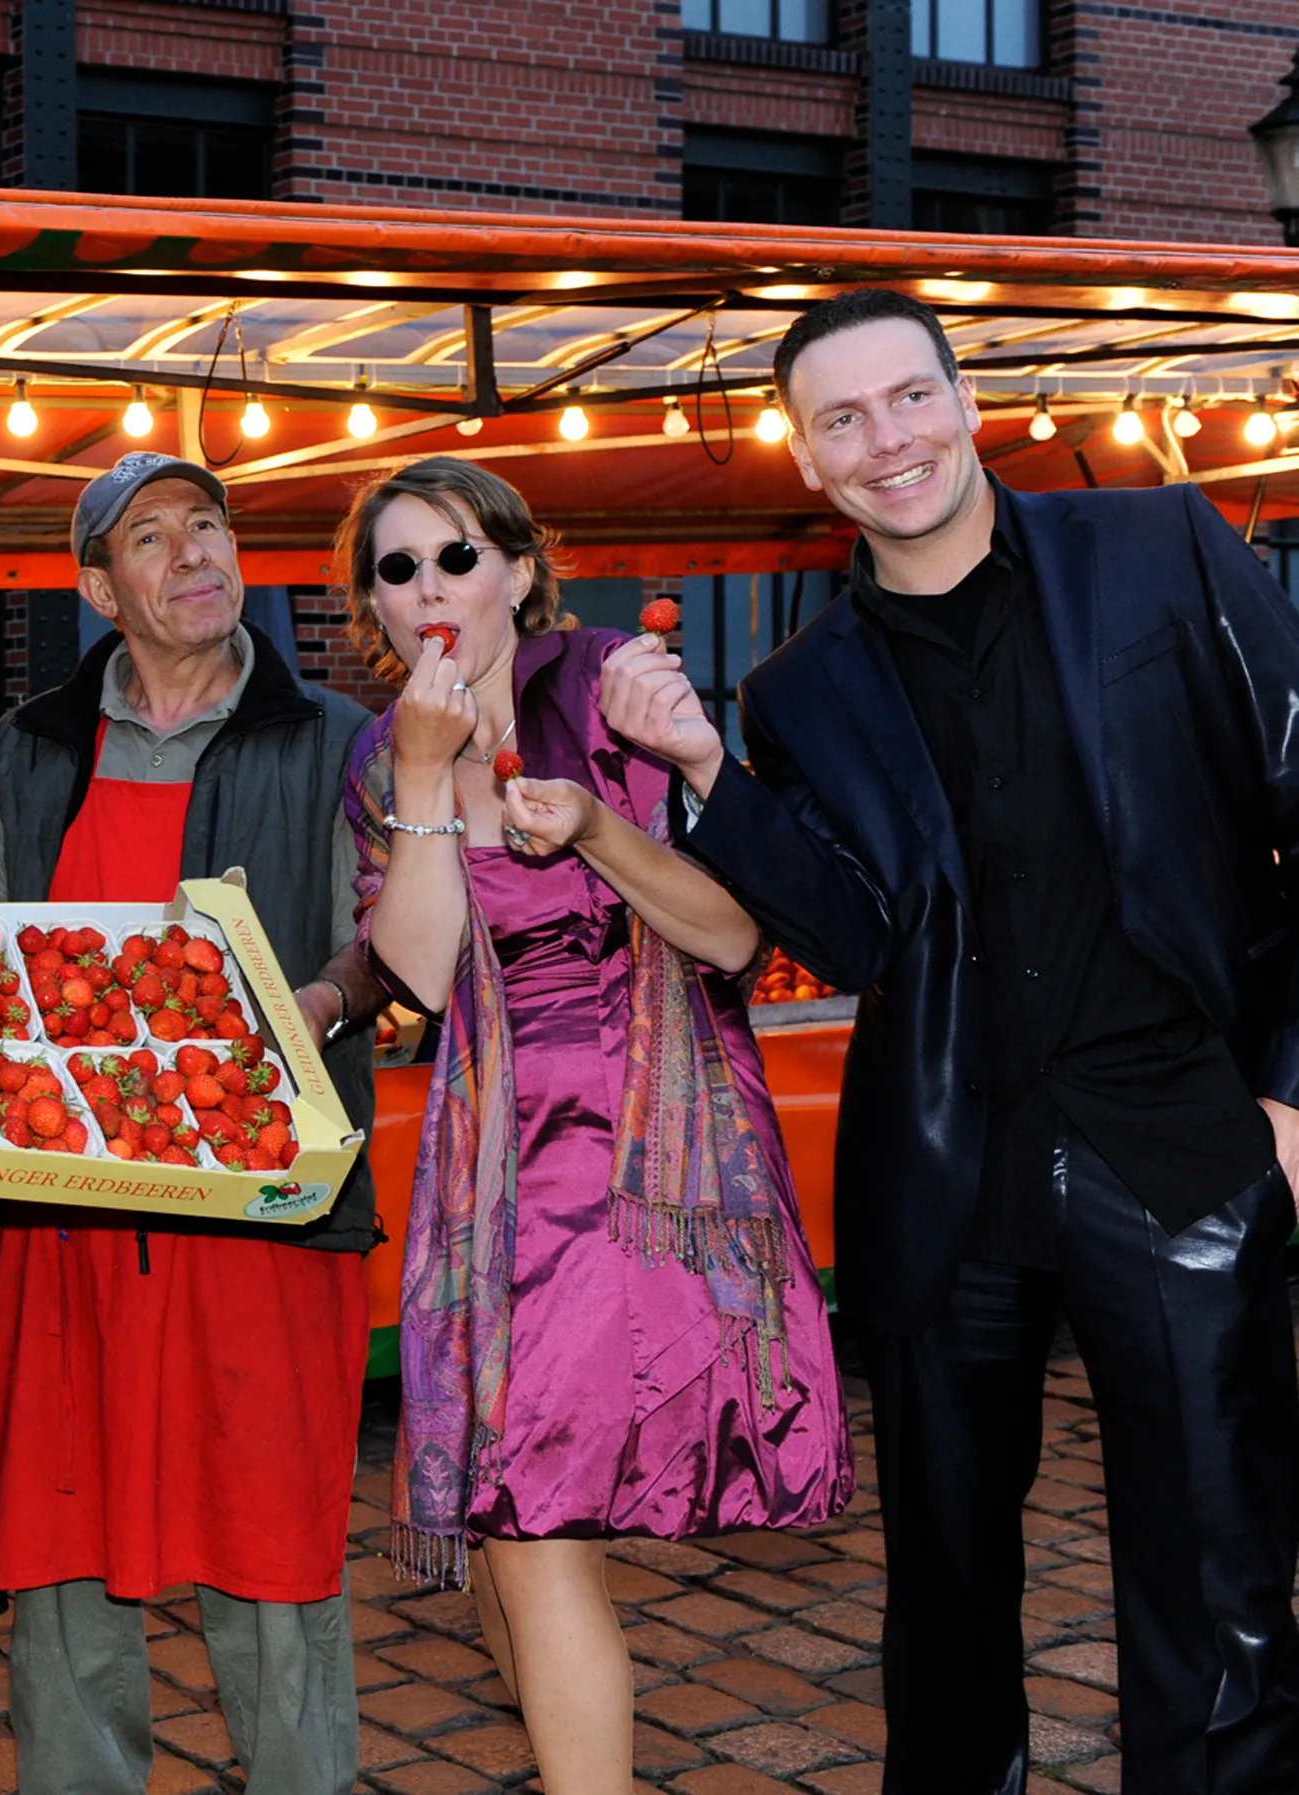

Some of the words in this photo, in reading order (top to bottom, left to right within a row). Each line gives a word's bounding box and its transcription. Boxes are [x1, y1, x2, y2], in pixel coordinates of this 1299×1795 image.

[232, 917, 282, 999] ERDBEEREN
[274, 1001, 325, 1096] GLEIDINGER
[62, 1172, 214, 1202] ERDBEEREN
